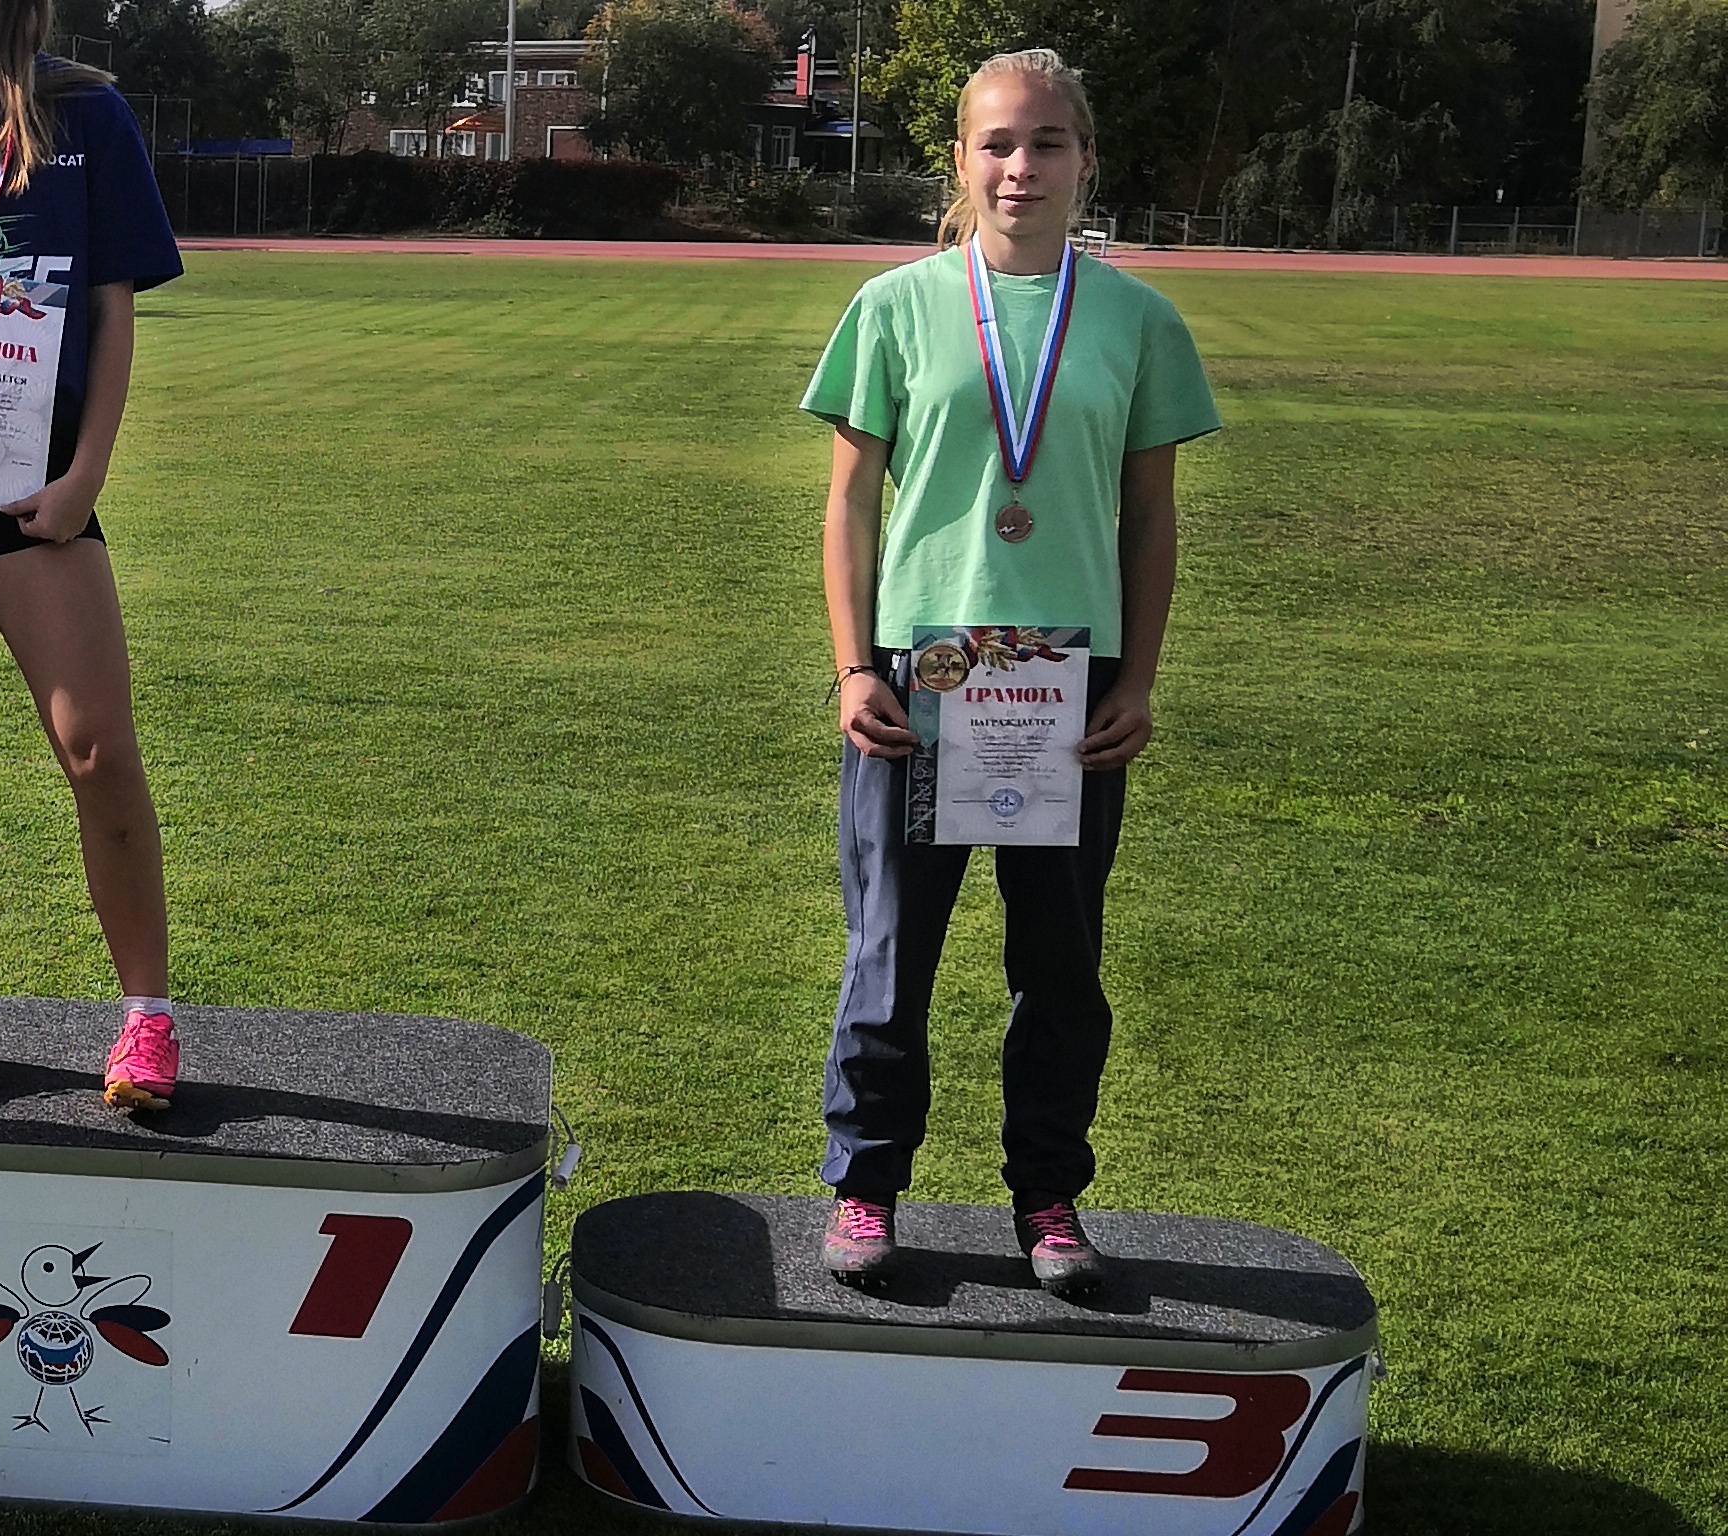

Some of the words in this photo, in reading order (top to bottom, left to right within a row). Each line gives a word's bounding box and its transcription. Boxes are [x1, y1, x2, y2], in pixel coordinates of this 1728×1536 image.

[965, 686, 1064, 704] ГРАМОТА
[288, 1213, 413, 1339] 1
[1062, 1368, 1311, 1499] 3
